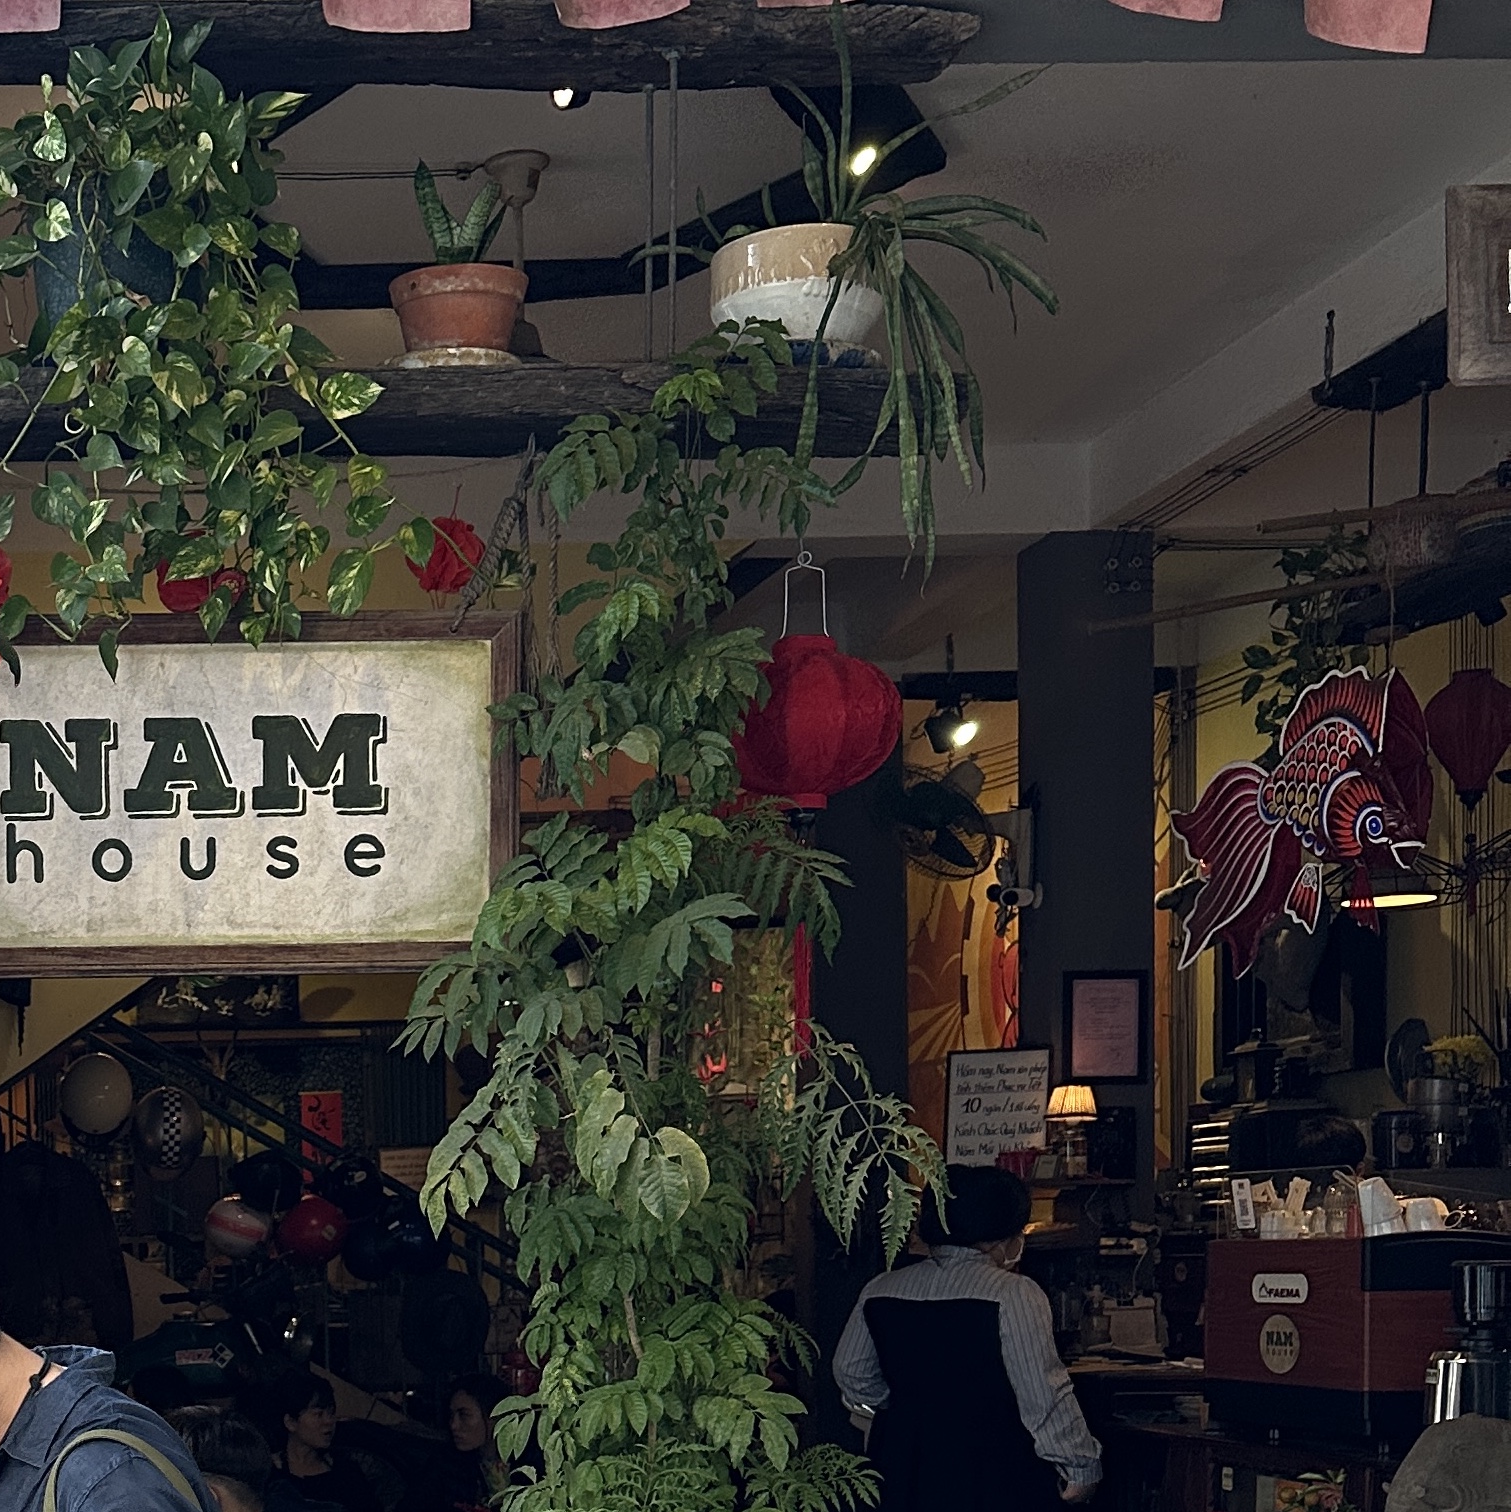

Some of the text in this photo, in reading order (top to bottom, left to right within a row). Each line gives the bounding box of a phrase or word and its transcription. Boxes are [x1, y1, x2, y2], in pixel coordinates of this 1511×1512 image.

[0, 714, 388, 821] NAM
[6, 823, 385, 883] house
[961, 1097, 982, 1113] 10
[1269, 1288, 1300, 1298] FAEMA
[1266, 1331, 1293, 1347] NAM
